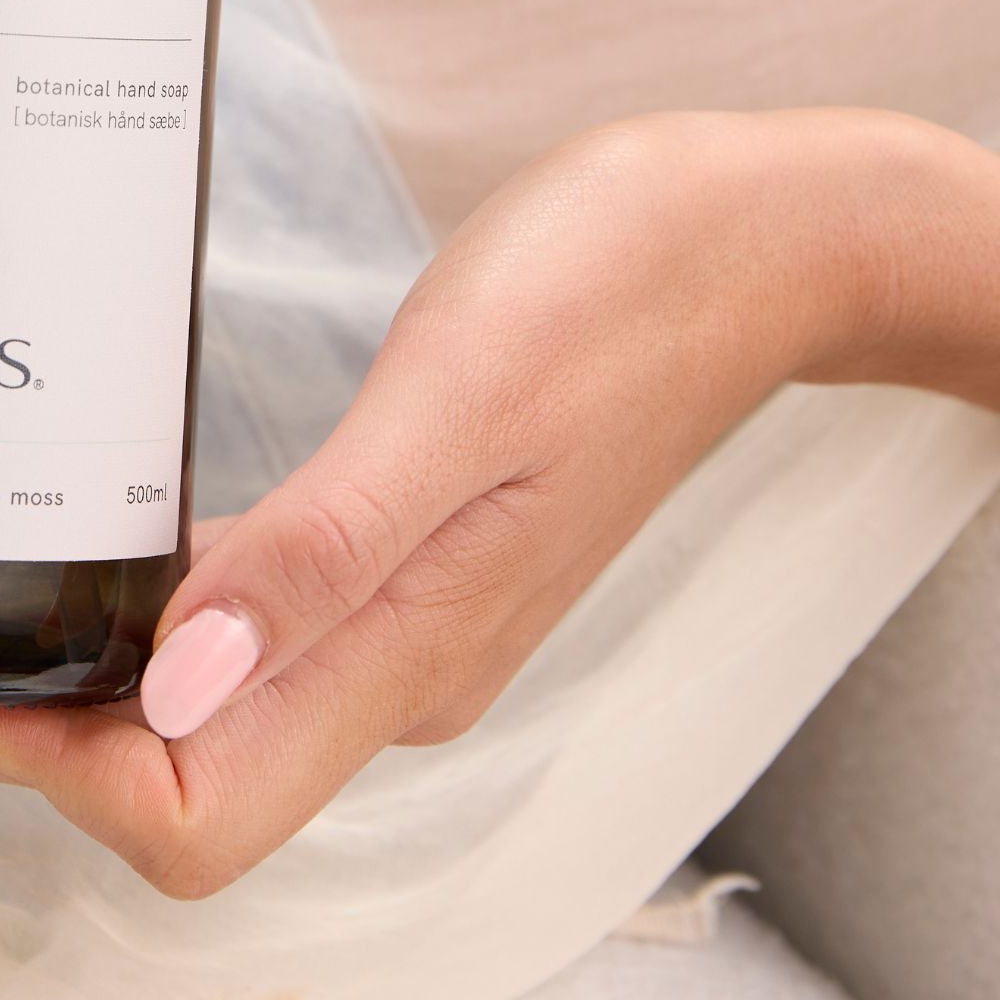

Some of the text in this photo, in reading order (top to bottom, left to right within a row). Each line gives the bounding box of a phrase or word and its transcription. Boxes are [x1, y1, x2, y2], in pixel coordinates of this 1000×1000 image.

[16, 76, 189, 101] botanical hand soap
[108, 111, 145, 129] hånd
[10, 488, 64, 506] moss
[126, 483, 167, 504] 500ml
